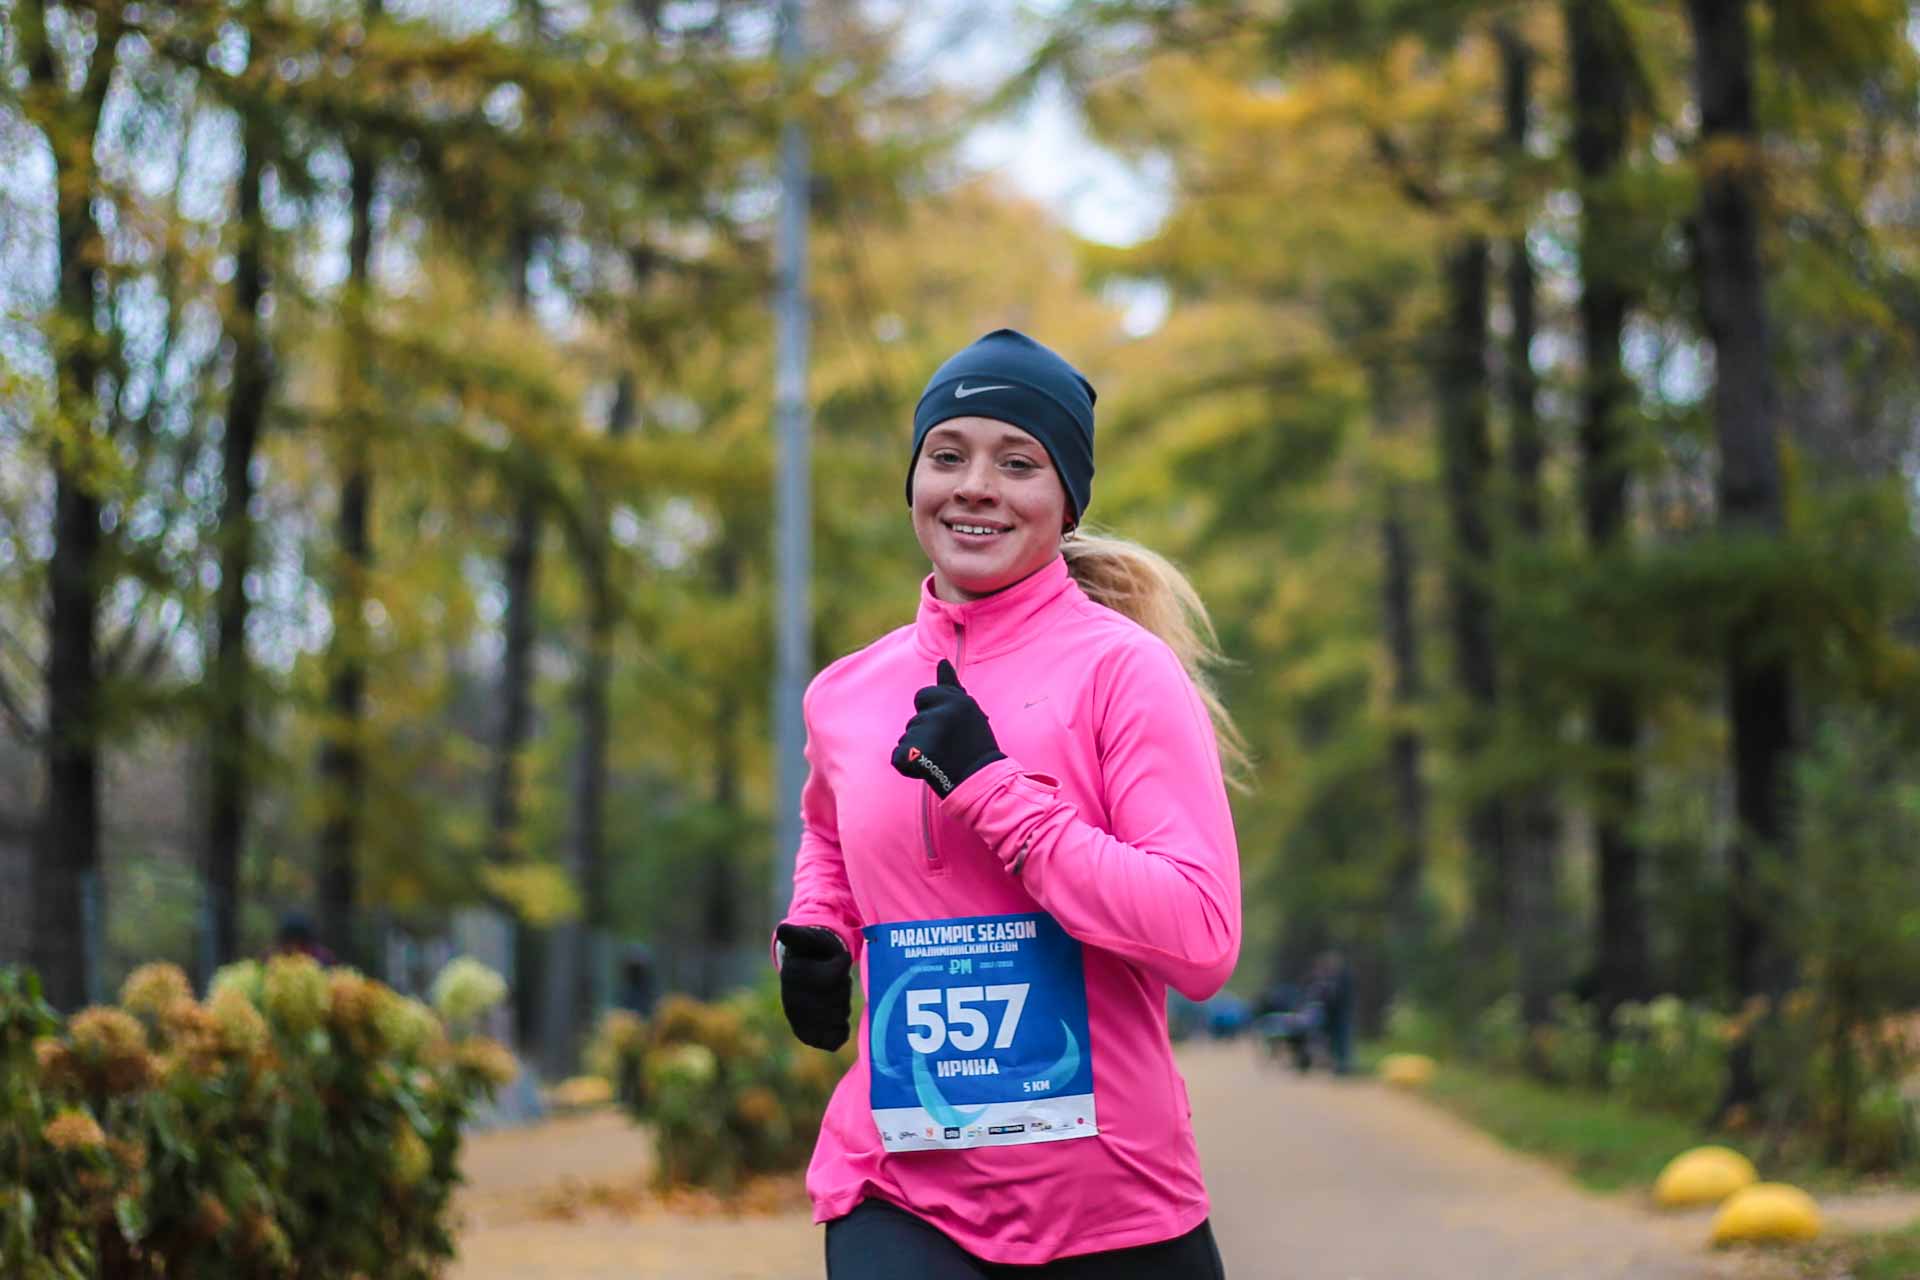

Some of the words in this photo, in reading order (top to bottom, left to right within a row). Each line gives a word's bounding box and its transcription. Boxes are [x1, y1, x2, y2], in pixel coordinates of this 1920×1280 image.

[918, 754, 954, 792] Reebok
[890, 924, 975, 947] PARALYMPIC
[977, 921, 1037, 941] SEASON
[989, 941, 1019, 953] СЕЗОН
[905, 983, 1031, 1054] 557
[937, 1058, 999, 1078] ИРИНА
[1023, 1081, 1031, 1092] 5
